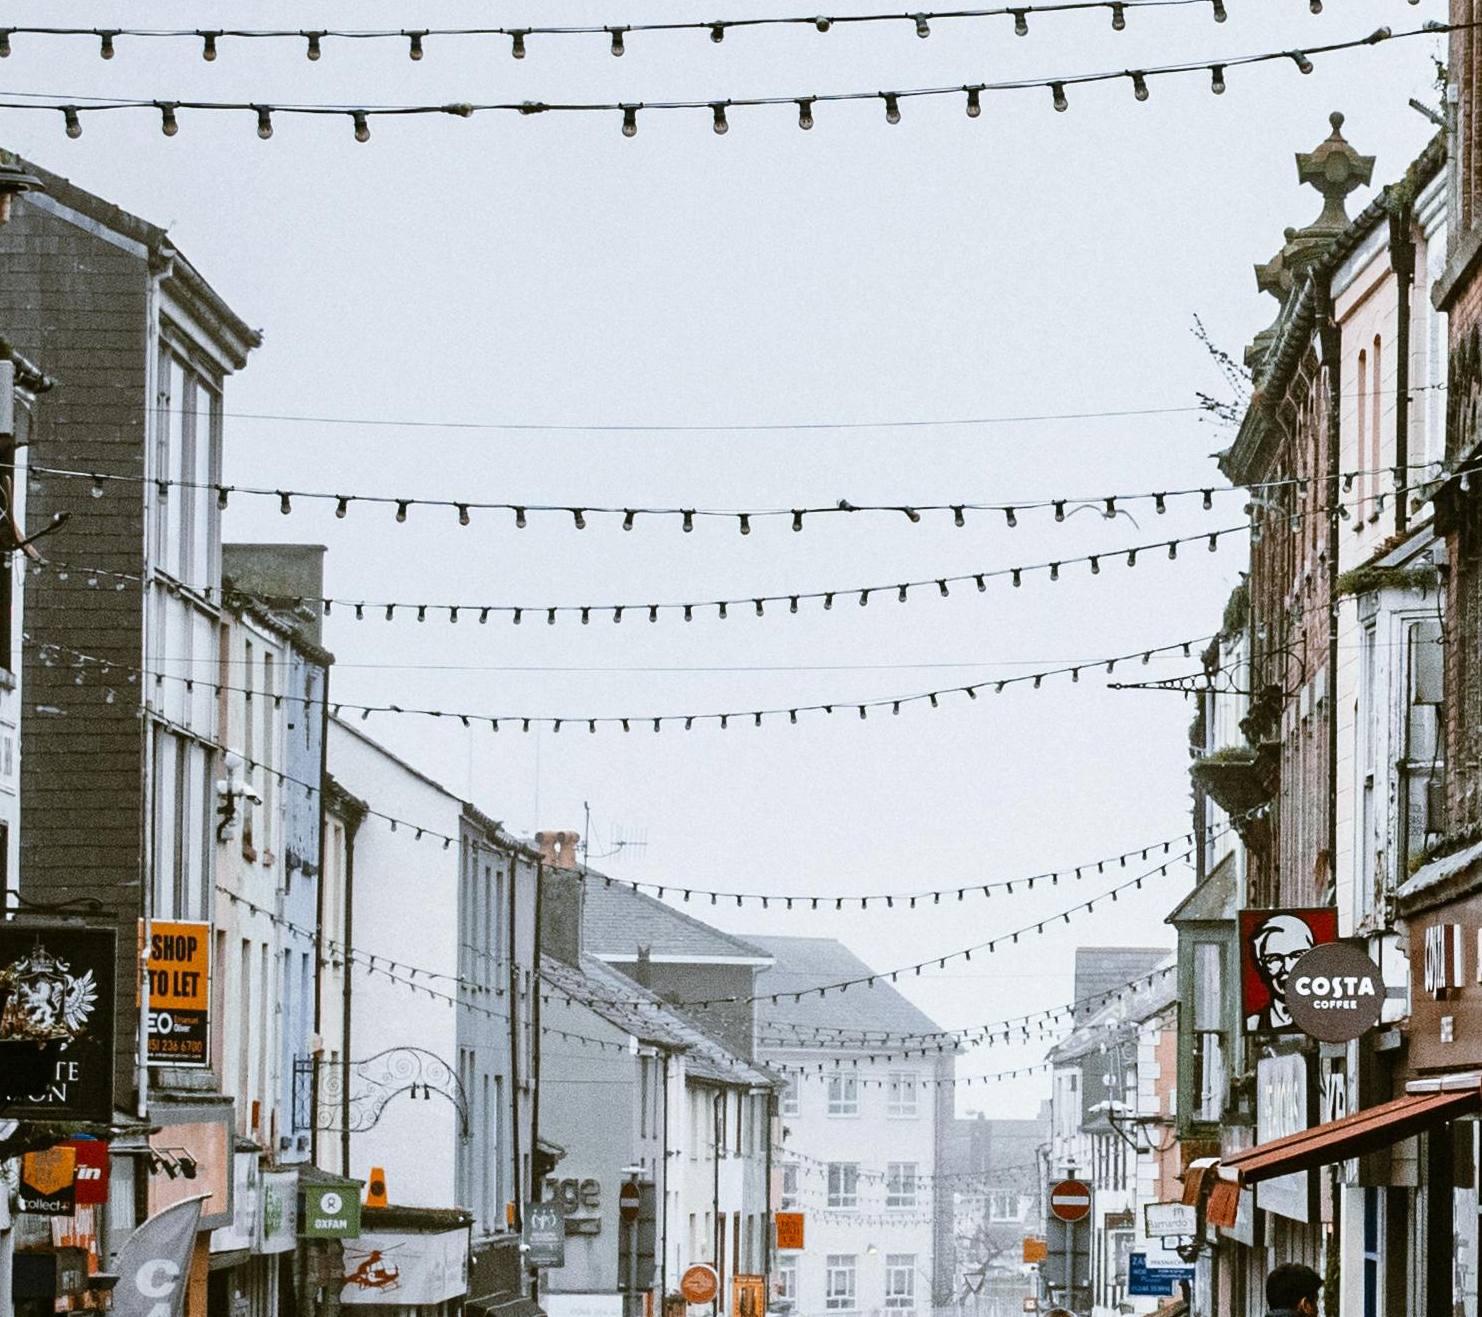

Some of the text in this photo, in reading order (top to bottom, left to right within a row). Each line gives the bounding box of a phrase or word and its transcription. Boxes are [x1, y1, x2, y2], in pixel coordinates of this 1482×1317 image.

[151, 933, 198, 962] SHOP
[173, 971, 200, 998] LET
[1295, 975, 1376, 999] COSTA
[1313, 999, 1358, 1011] COFFEE
[314, 1218, 348, 1230] OXFAM
